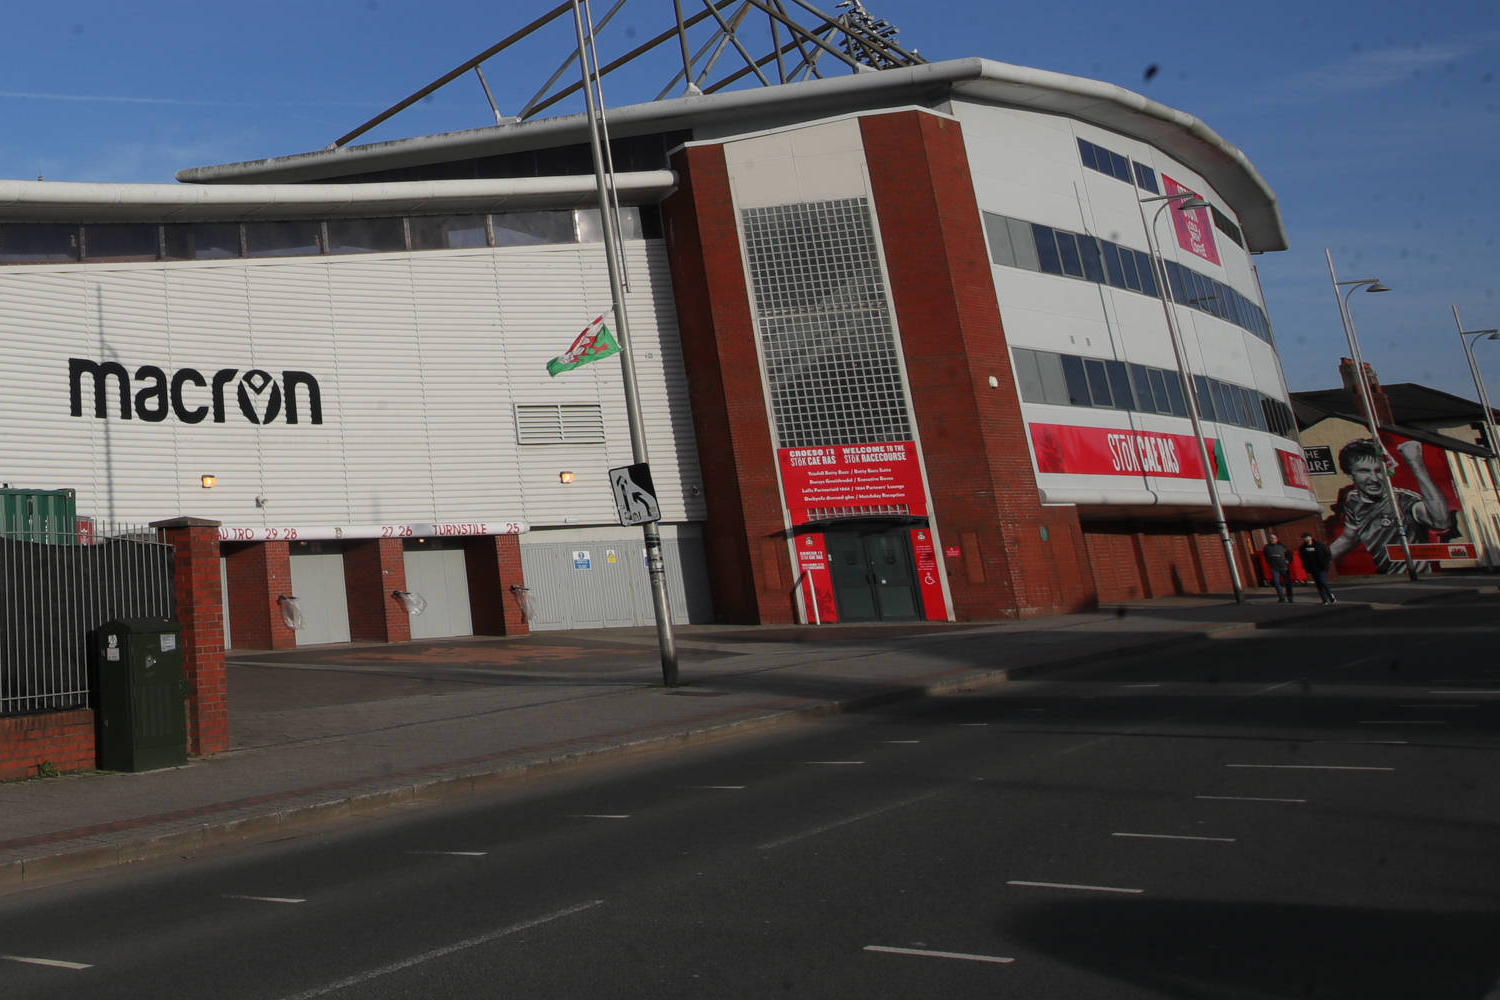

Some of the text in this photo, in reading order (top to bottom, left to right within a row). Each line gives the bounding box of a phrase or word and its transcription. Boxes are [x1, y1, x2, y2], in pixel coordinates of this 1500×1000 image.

[68, 357, 323, 425] macron
[842, 445, 885, 454] WELCOME
[1136, 435, 1162, 472] CAE
[1157, 437, 1180, 473] RAS
[1304, 450, 1320, 459] HE
[807, 456, 821, 466] CAE
[822, 455, 836, 465] RAS
[861, 451, 906, 464] RACECOURSE
[1307, 460, 1330, 471] URF
[265, 528, 278, 540] 29
[283, 528, 298, 540] 28
[382, 526, 394, 538] 27
[398, 525, 413, 537] 26
[432, 523, 488, 537] TURNSTILE
[506, 522, 520, 535] 25
